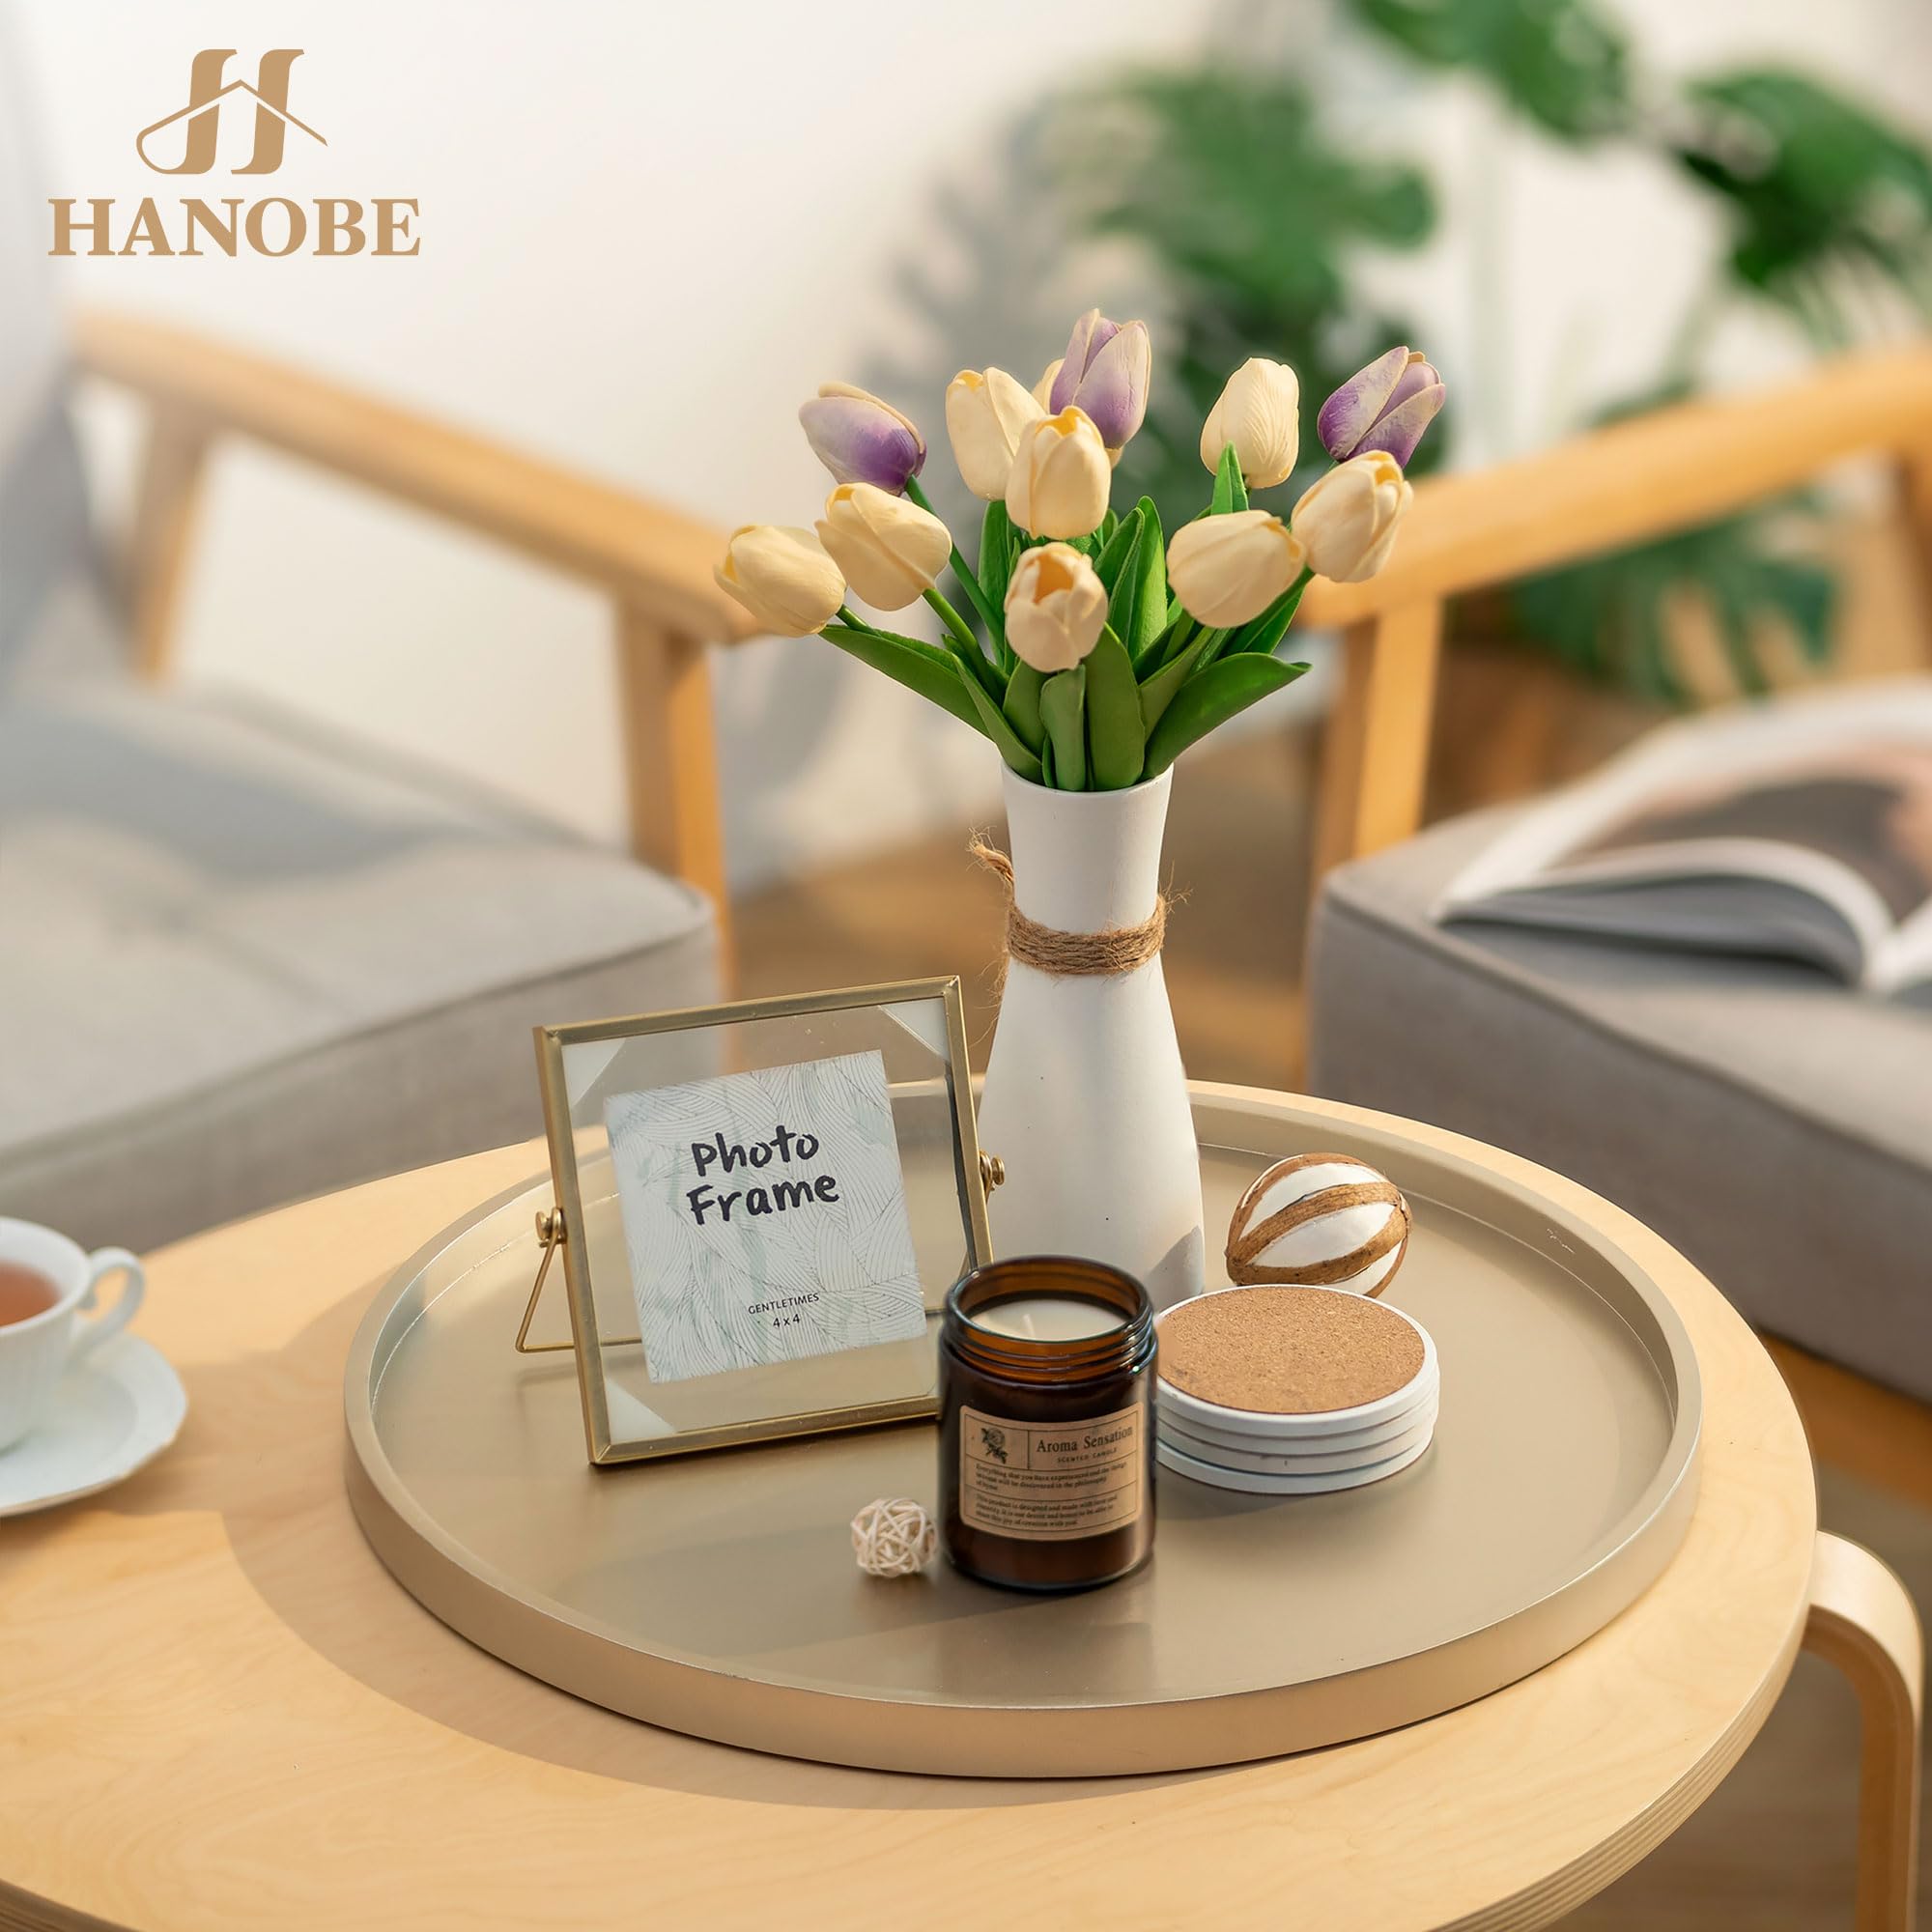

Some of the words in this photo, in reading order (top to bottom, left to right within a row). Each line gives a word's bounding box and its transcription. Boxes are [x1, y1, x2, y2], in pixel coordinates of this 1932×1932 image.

[687, 1176, 839, 1225] Frame
[749, 1293, 819, 1315] GENTLETIMES
[774, 1318, 781, 1327] 4
[792, 1314, 800, 1324] 4
[1036, 1438, 1078, 1453] Aroma
[1083, 1426, 1133, 1450] Sensation
